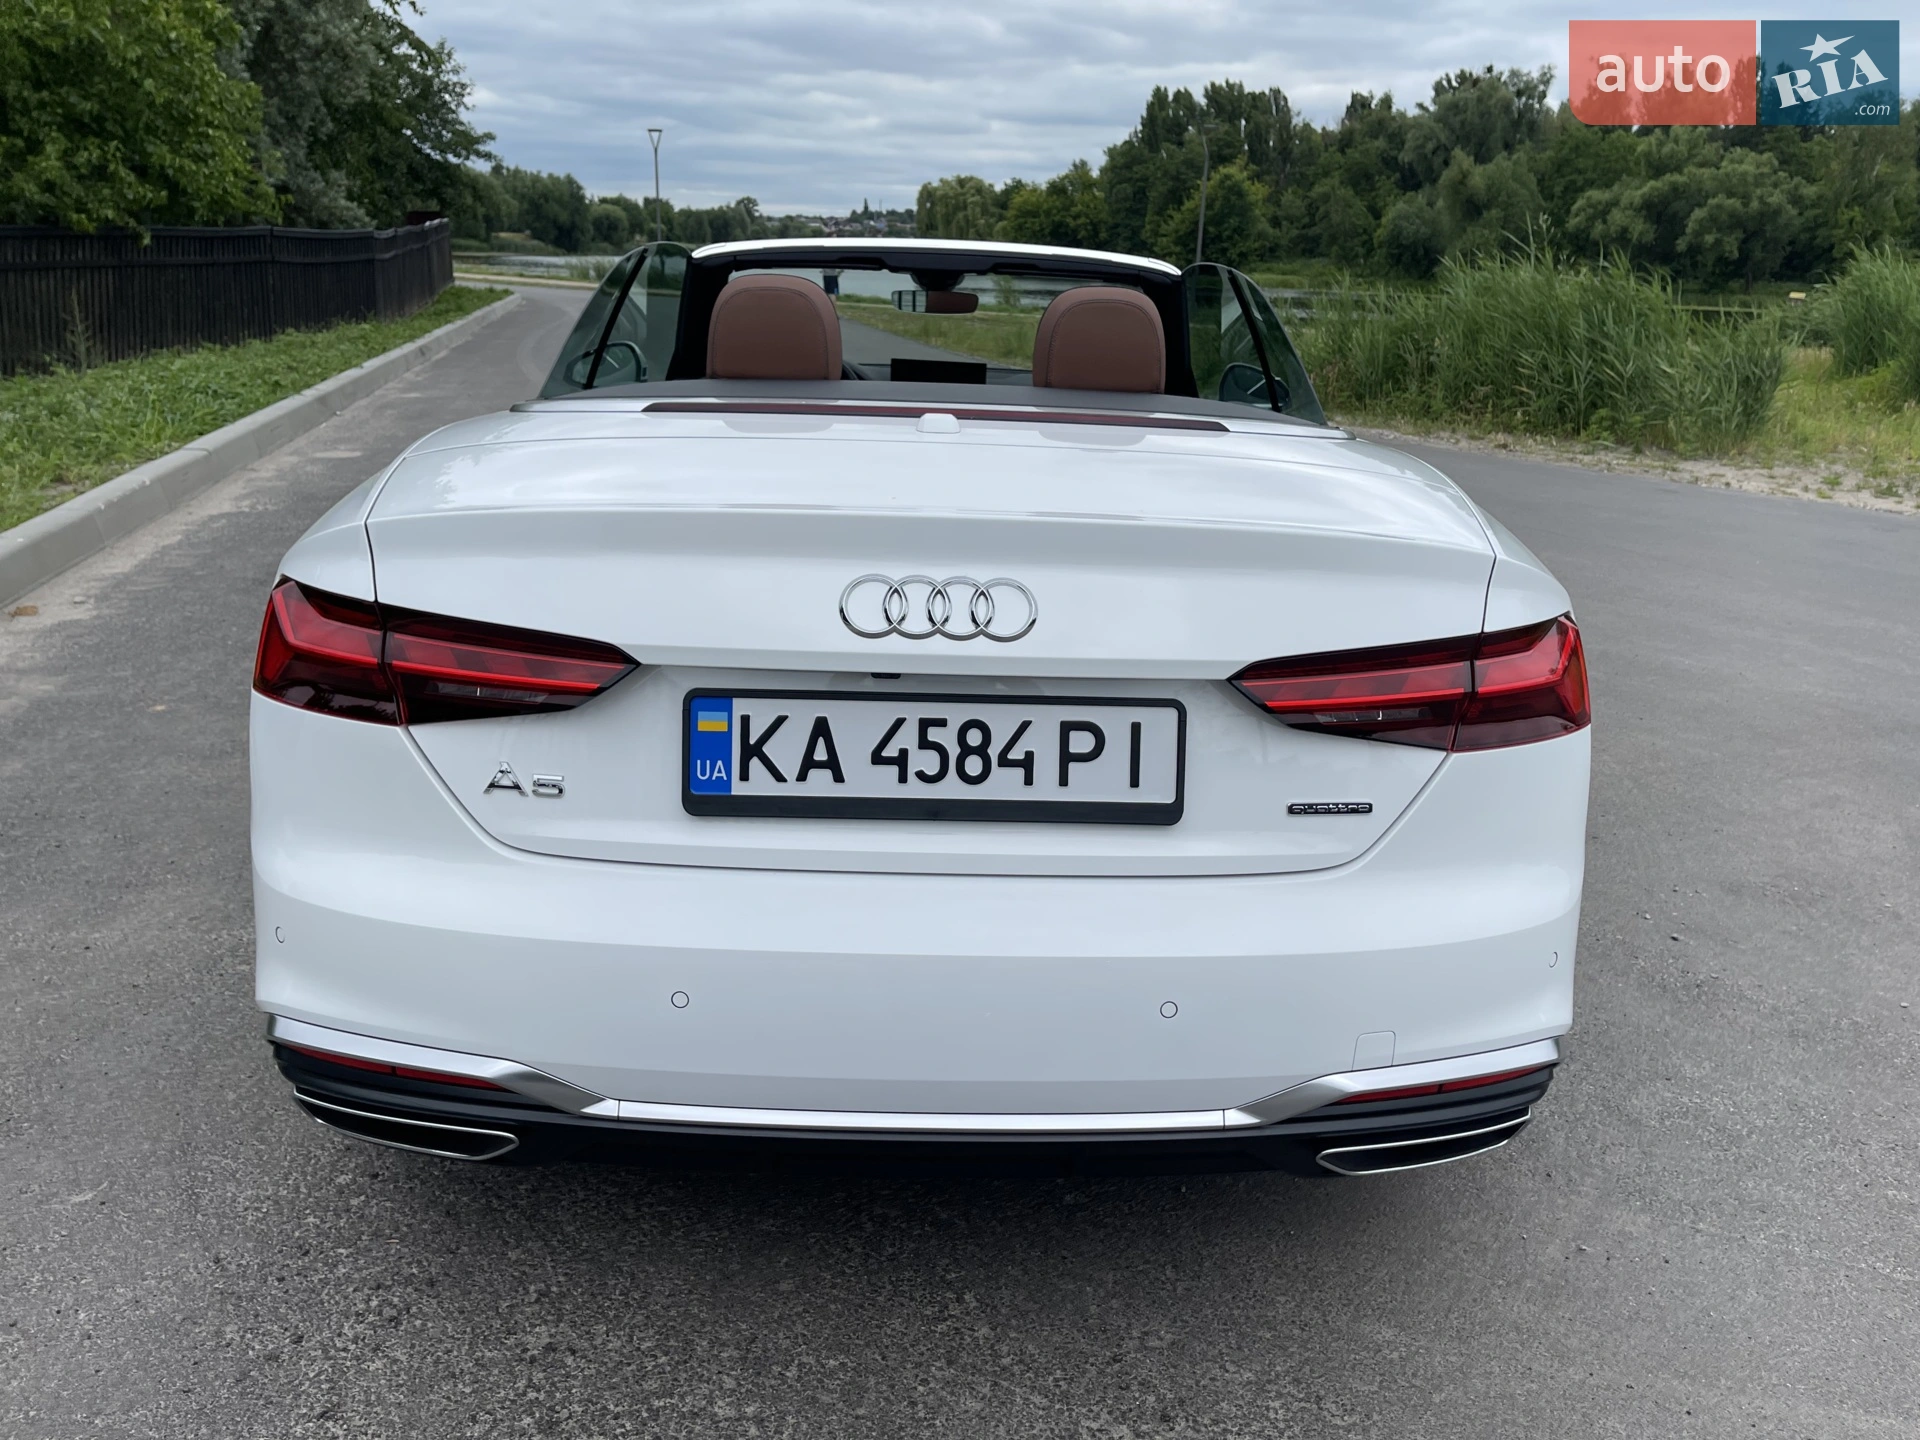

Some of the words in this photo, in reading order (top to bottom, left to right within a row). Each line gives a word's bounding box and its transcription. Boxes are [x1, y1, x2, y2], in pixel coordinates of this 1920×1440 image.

[738, 714, 845, 784] KA
[870, 717, 1034, 787] 4584
[1058, 720, 1142, 789] PI
[482, 761, 566, 799] A5
[696, 759, 728, 781] UA
[1291, 803, 1370, 814] quattro
